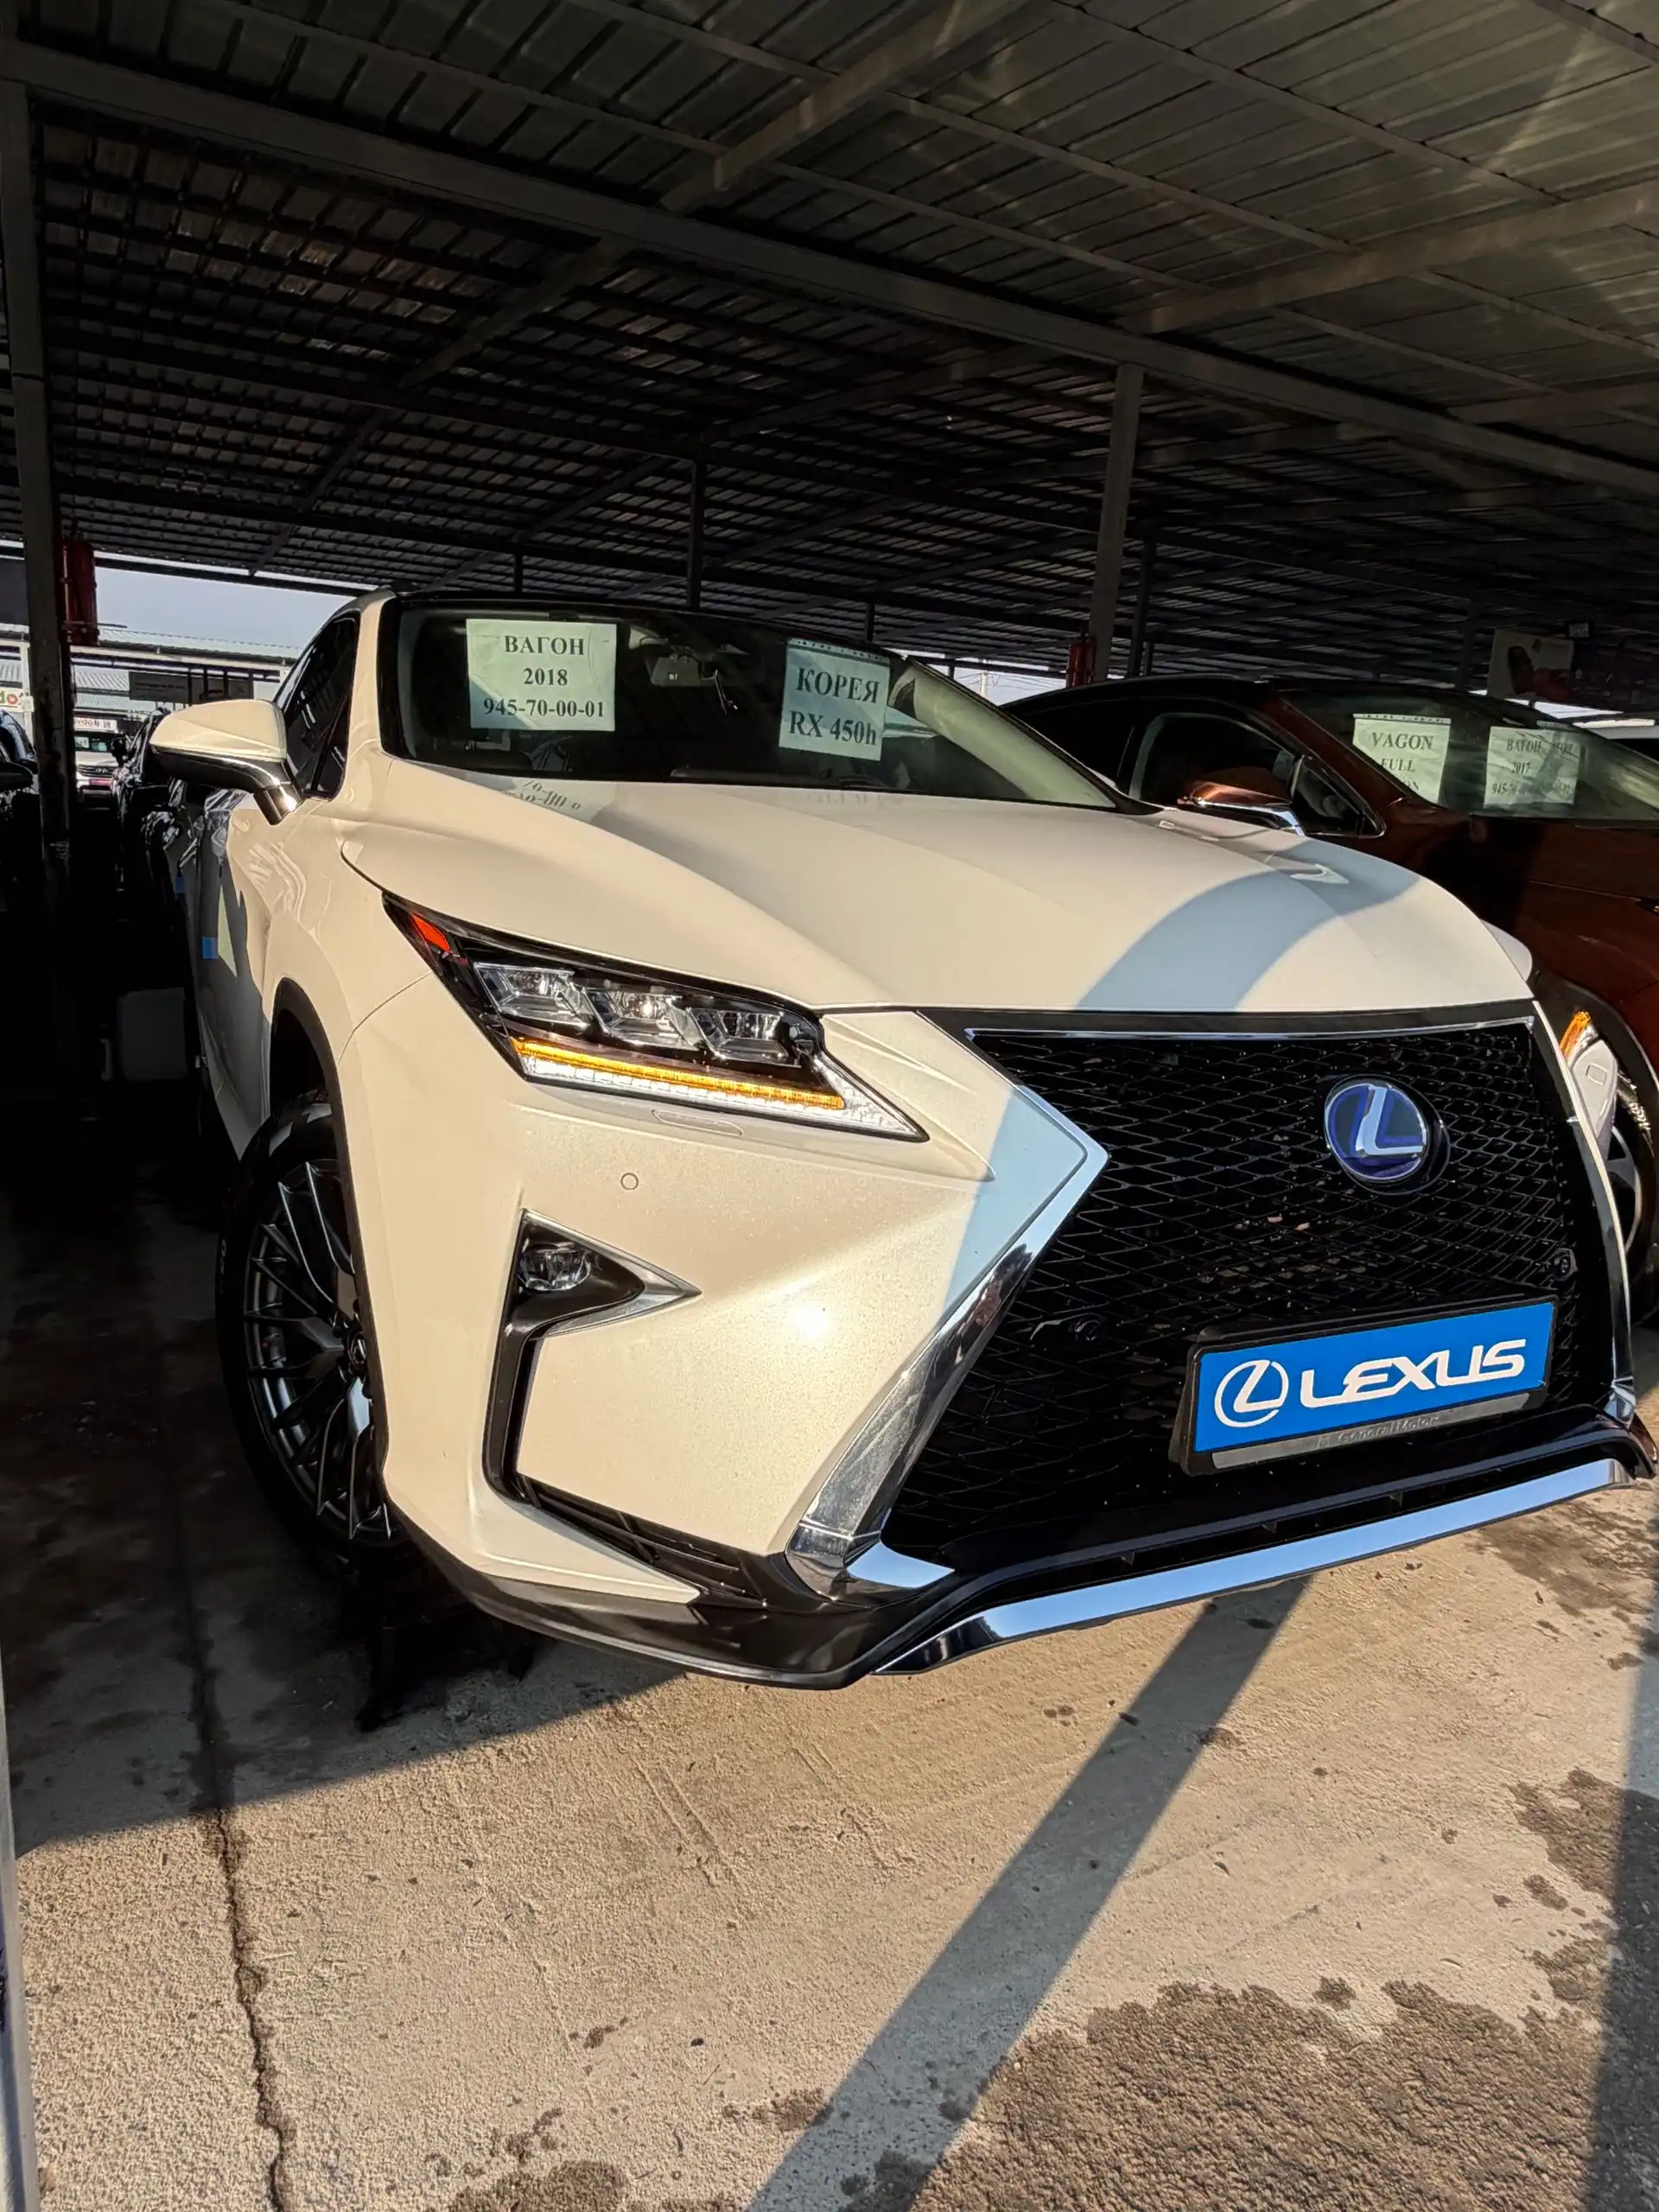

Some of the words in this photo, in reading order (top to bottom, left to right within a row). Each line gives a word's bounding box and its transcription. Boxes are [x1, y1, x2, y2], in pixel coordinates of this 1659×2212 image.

[505, 635, 585, 656] ВАГОН
[524, 667, 569, 686] 2018
[796, 667, 881, 704] КОРЕЯ
[483, 697, 605, 718] 945-70-00-01
[790, 709, 823, 738] RX
[830, 717, 877, 746] 450h
[1371, 731, 1434, 751] VAGON
[1382, 757, 1416, 773] FULL
[1300, 1338, 1527, 1408] LEXUS
